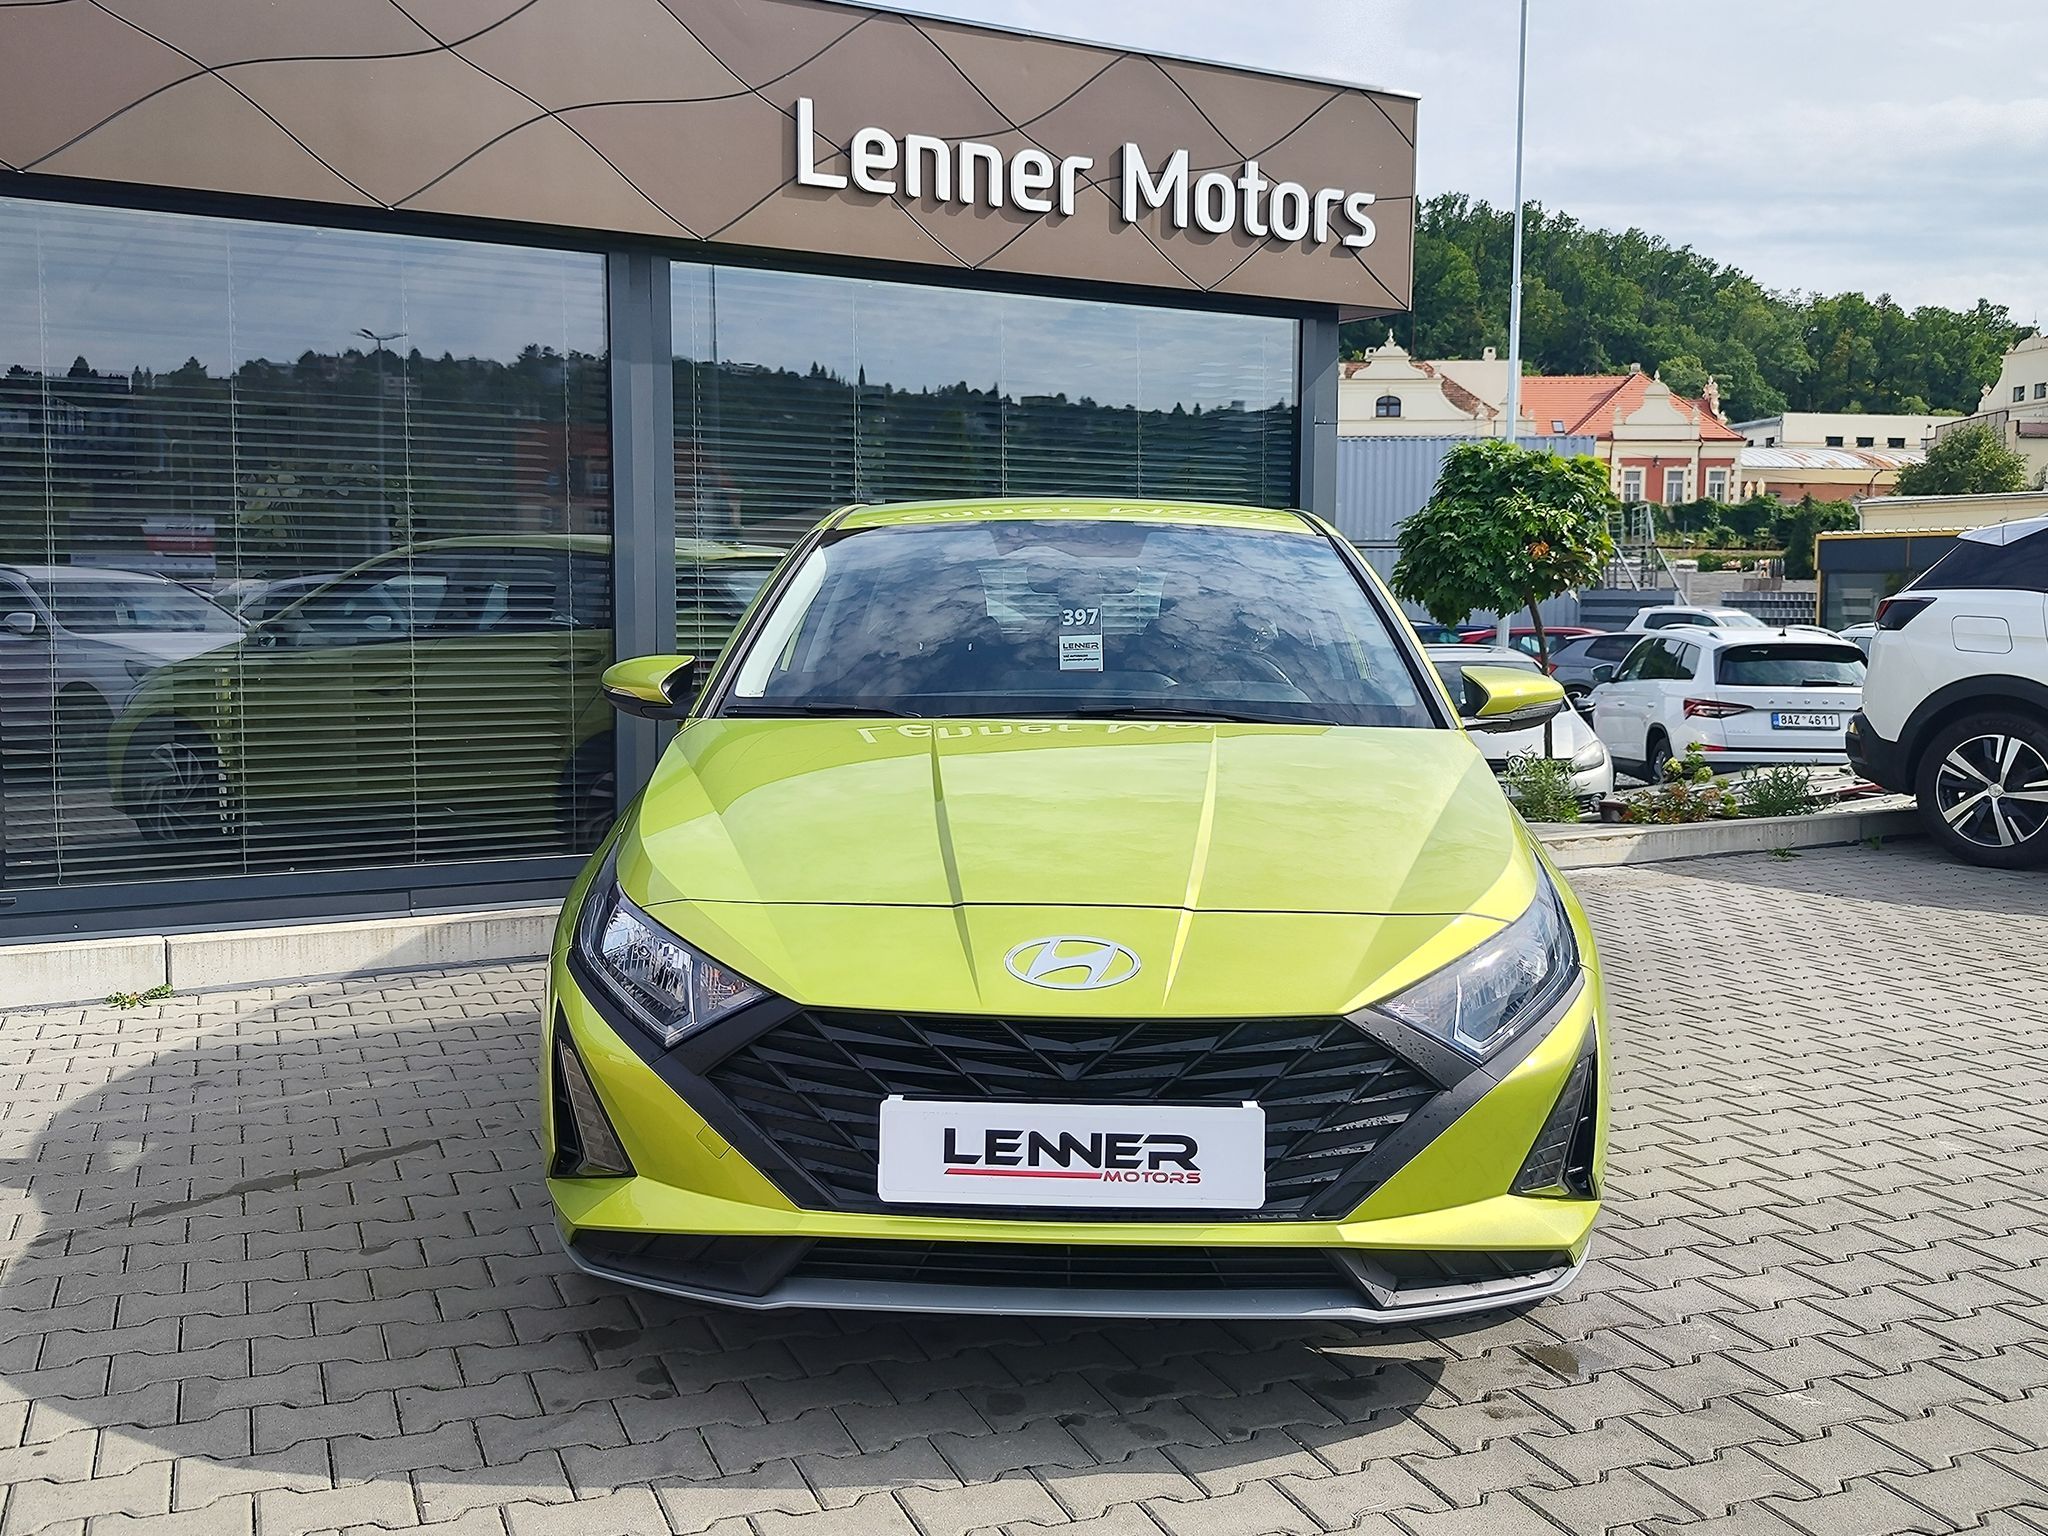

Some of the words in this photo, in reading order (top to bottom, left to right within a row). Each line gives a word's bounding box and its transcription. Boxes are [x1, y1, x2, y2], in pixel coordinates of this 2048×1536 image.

[797, 97, 1094, 216] Lenner
[1122, 142, 1376, 248] Motors
[1062, 608, 1099, 626] 397
[1063, 642, 1099, 650] LENNER
[1780, 714, 1800, 725] 8AZ
[1808, 715, 1834, 726] 4611
[943, 1127, 1201, 1171] LENNER
[1102, 1170, 1201, 1184] MOTORS
